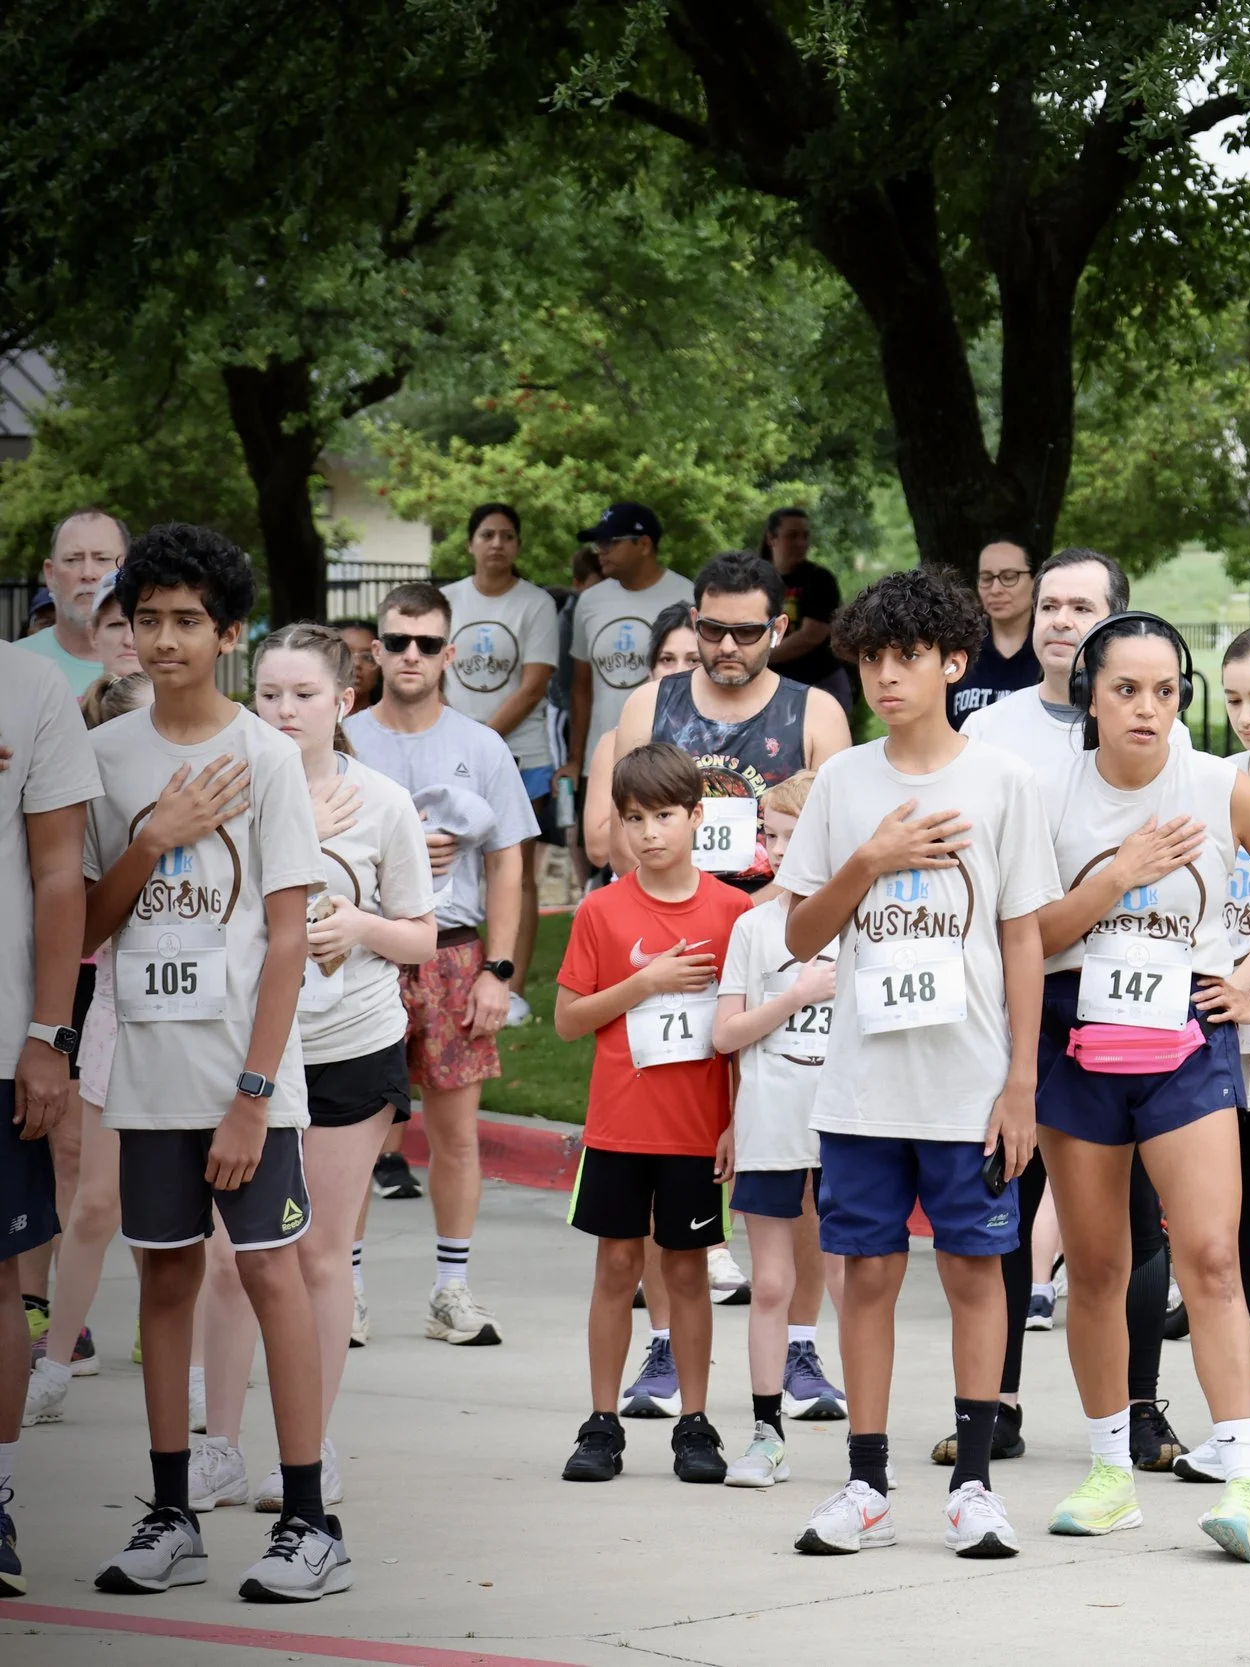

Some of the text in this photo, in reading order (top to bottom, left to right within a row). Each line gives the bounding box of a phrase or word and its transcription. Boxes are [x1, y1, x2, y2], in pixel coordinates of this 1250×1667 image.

[598, 652, 648, 673] MUSTAN
[953, 688, 992, 716] FORT
[692, 825, 731, 851] 138
[136, 879, 222, 920] USTANG
[859, 904, 961, 943] MUSTANG
[145, 962, 198, 995] 105
[882, 971, 936, 1007] 148
[1108, 969, 1163, 1003] 147
[659, 1011, 693, 1042] 71
[785, 1005, 833, 1035] 123
